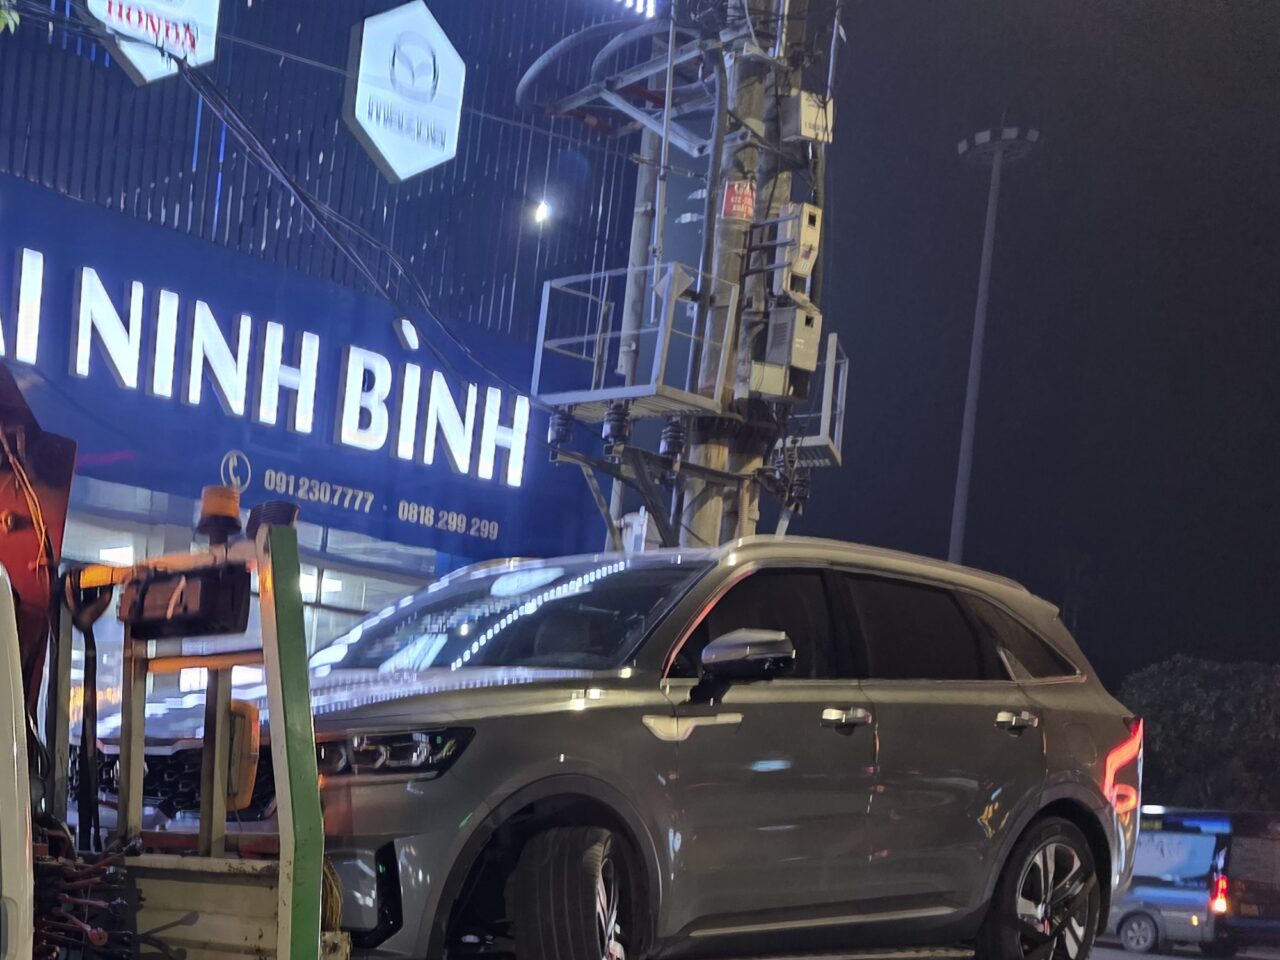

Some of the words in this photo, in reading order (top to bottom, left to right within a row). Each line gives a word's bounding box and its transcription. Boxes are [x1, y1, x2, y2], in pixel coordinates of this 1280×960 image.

[76, 266, 320, 434] NINH
[340, 317, 530, 487] BÌNH
[264, 469, 375, 513] 091.230.7777
[398, 500, 499, 540] 0818.299.299
